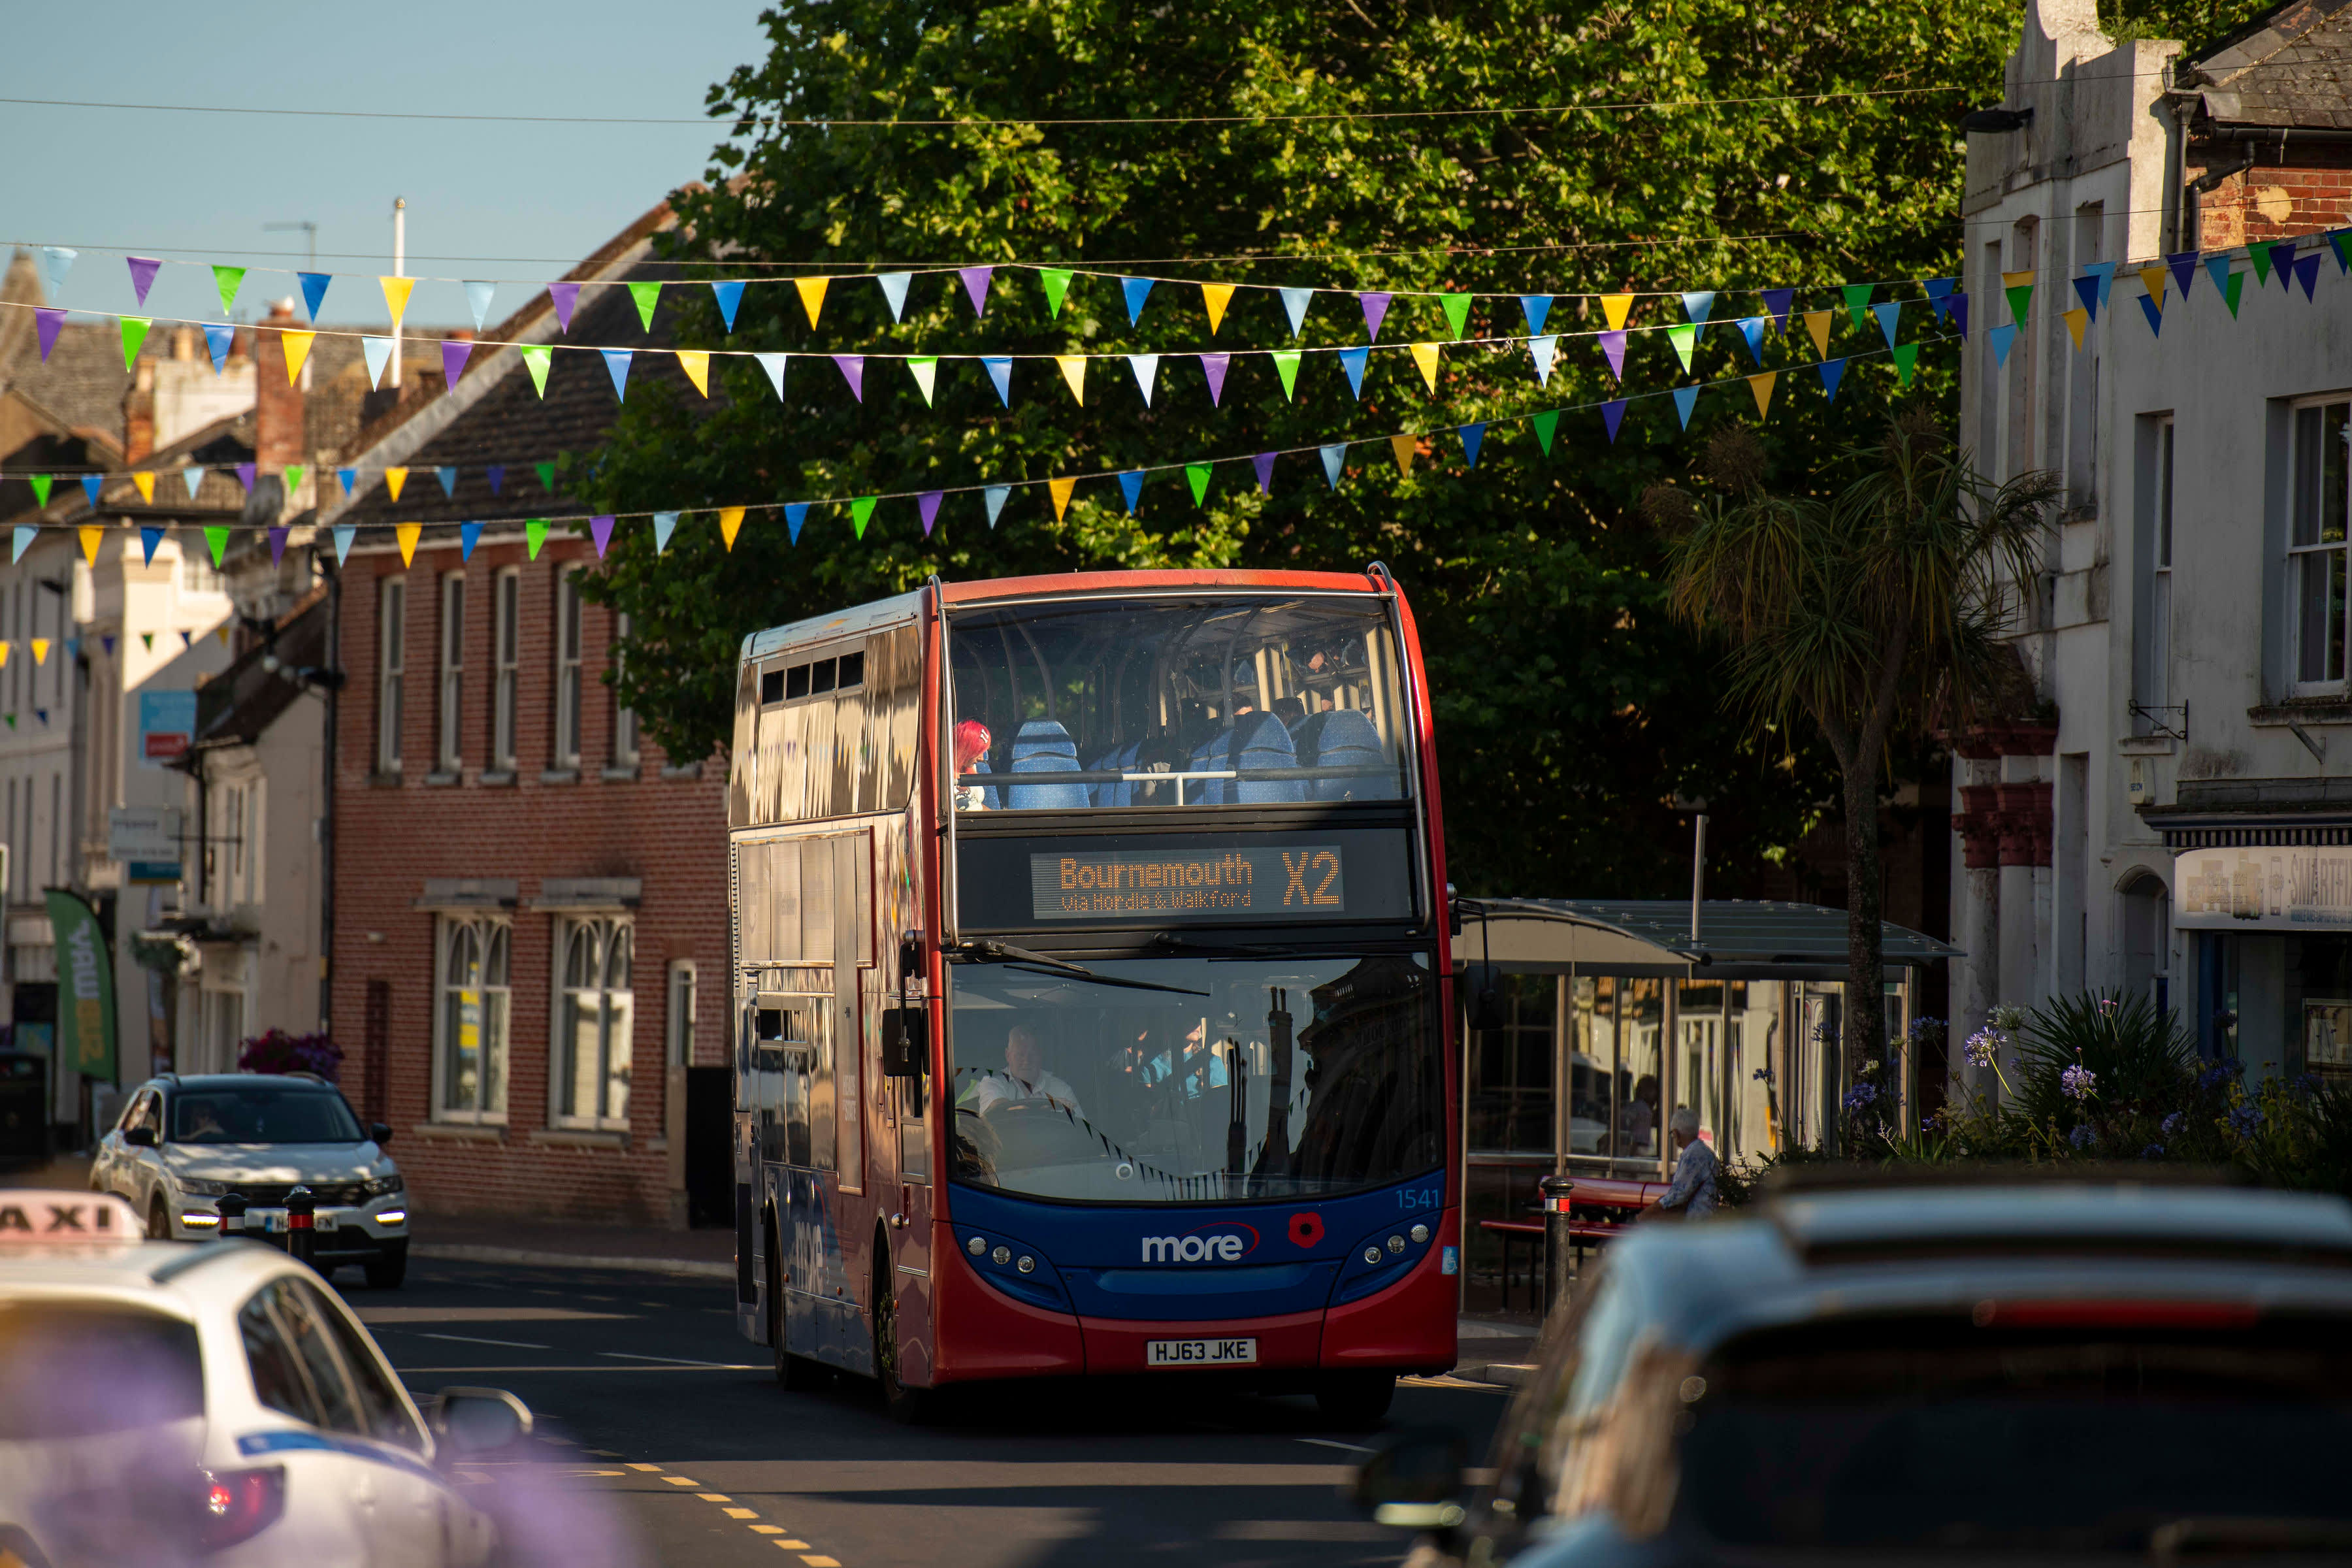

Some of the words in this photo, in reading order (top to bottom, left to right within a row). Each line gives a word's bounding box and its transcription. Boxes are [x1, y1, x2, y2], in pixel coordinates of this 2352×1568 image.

[1060, 853, 1252, 889] Bournemouth
[1282, 851, 1339, 905] X2
[1062, 894, 1088, 910] via
[1094, 892, 1150, 909] Hordle
[1154, 892, 1167, 909] &
[1171, 889, 1251, 908] Walkford
[1396, 1188, 1439, 1208] 1541
[0, 1205, 110, 1232] AXI
[1142, 1234, 1243, 1262] more
[1156, 1343, 1205, 1361] HJ63
[1212, 1341, 1248, 1360] JKE
